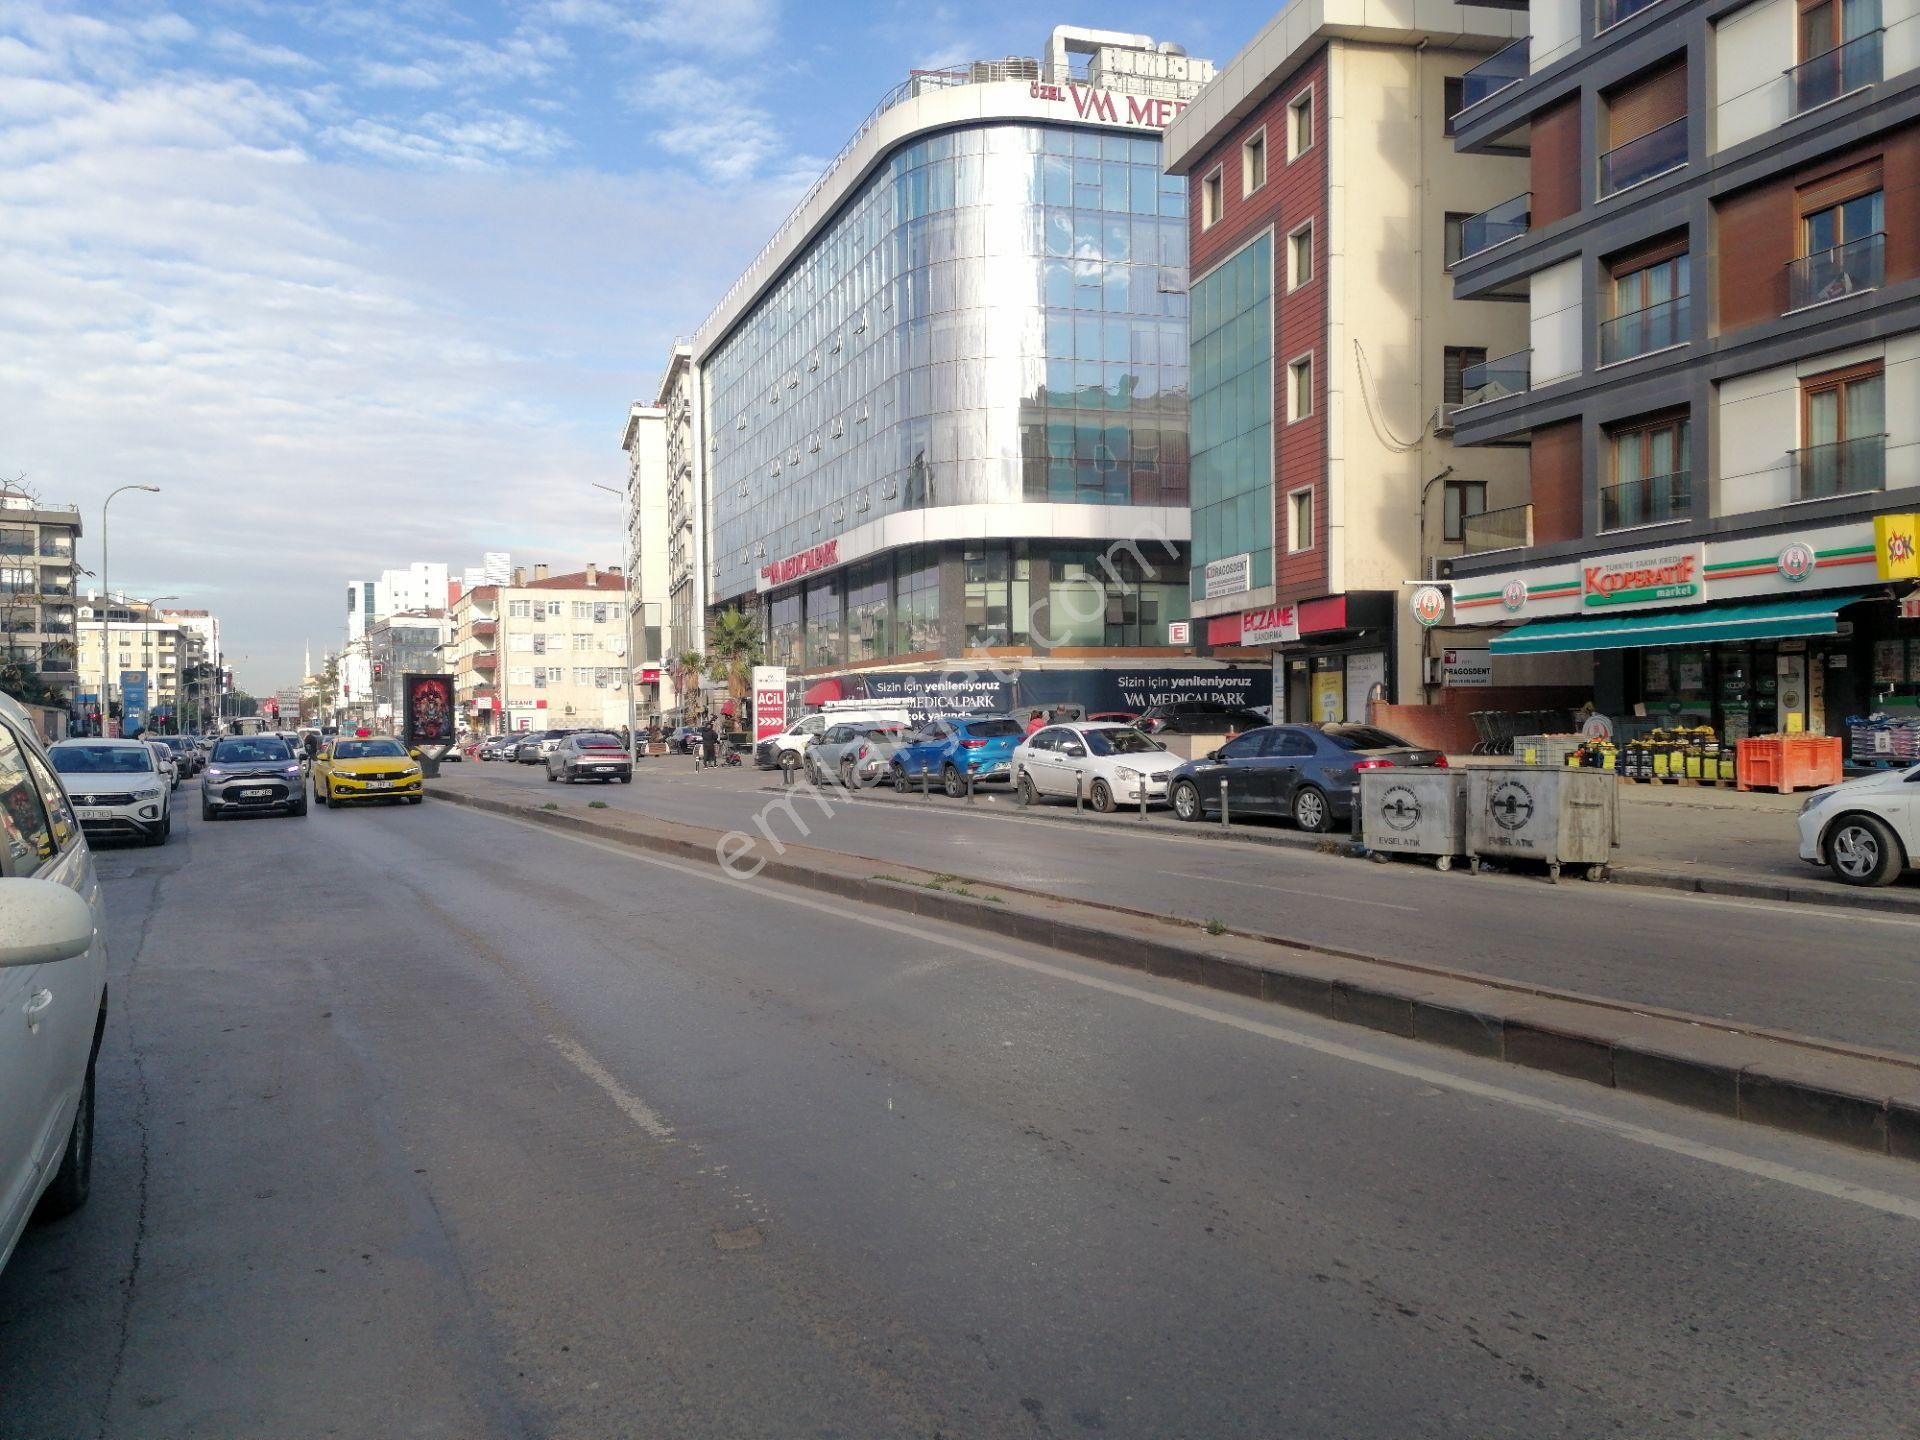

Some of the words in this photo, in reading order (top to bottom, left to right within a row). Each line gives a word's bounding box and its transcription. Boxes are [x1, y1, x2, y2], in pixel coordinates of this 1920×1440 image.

[1030, 81, 1066, 102] ÖZEL
[1656, 586, 1692, 597] market
[1243, 606, 1294, 632] ECZANE
[1173, 627, 1184, 640] E
[877, 682, 901, 692] Sizin
[904, 681, 922, 694] için
[925, 681, 1000, 694] yenileniyoruz
[1118, 676, 1145, 688] Sizin
[1148, 676, 1168, 689] için
[1171, 675, 1251, 689] yenileniyoruz
[1379, 837, 1401, 846] EVSEL
[1403, 838, 1420, 848] ATIK
[1488, 836, 1512, 846] EVSEL
[1515, 838, 1534, 848] ATIK
